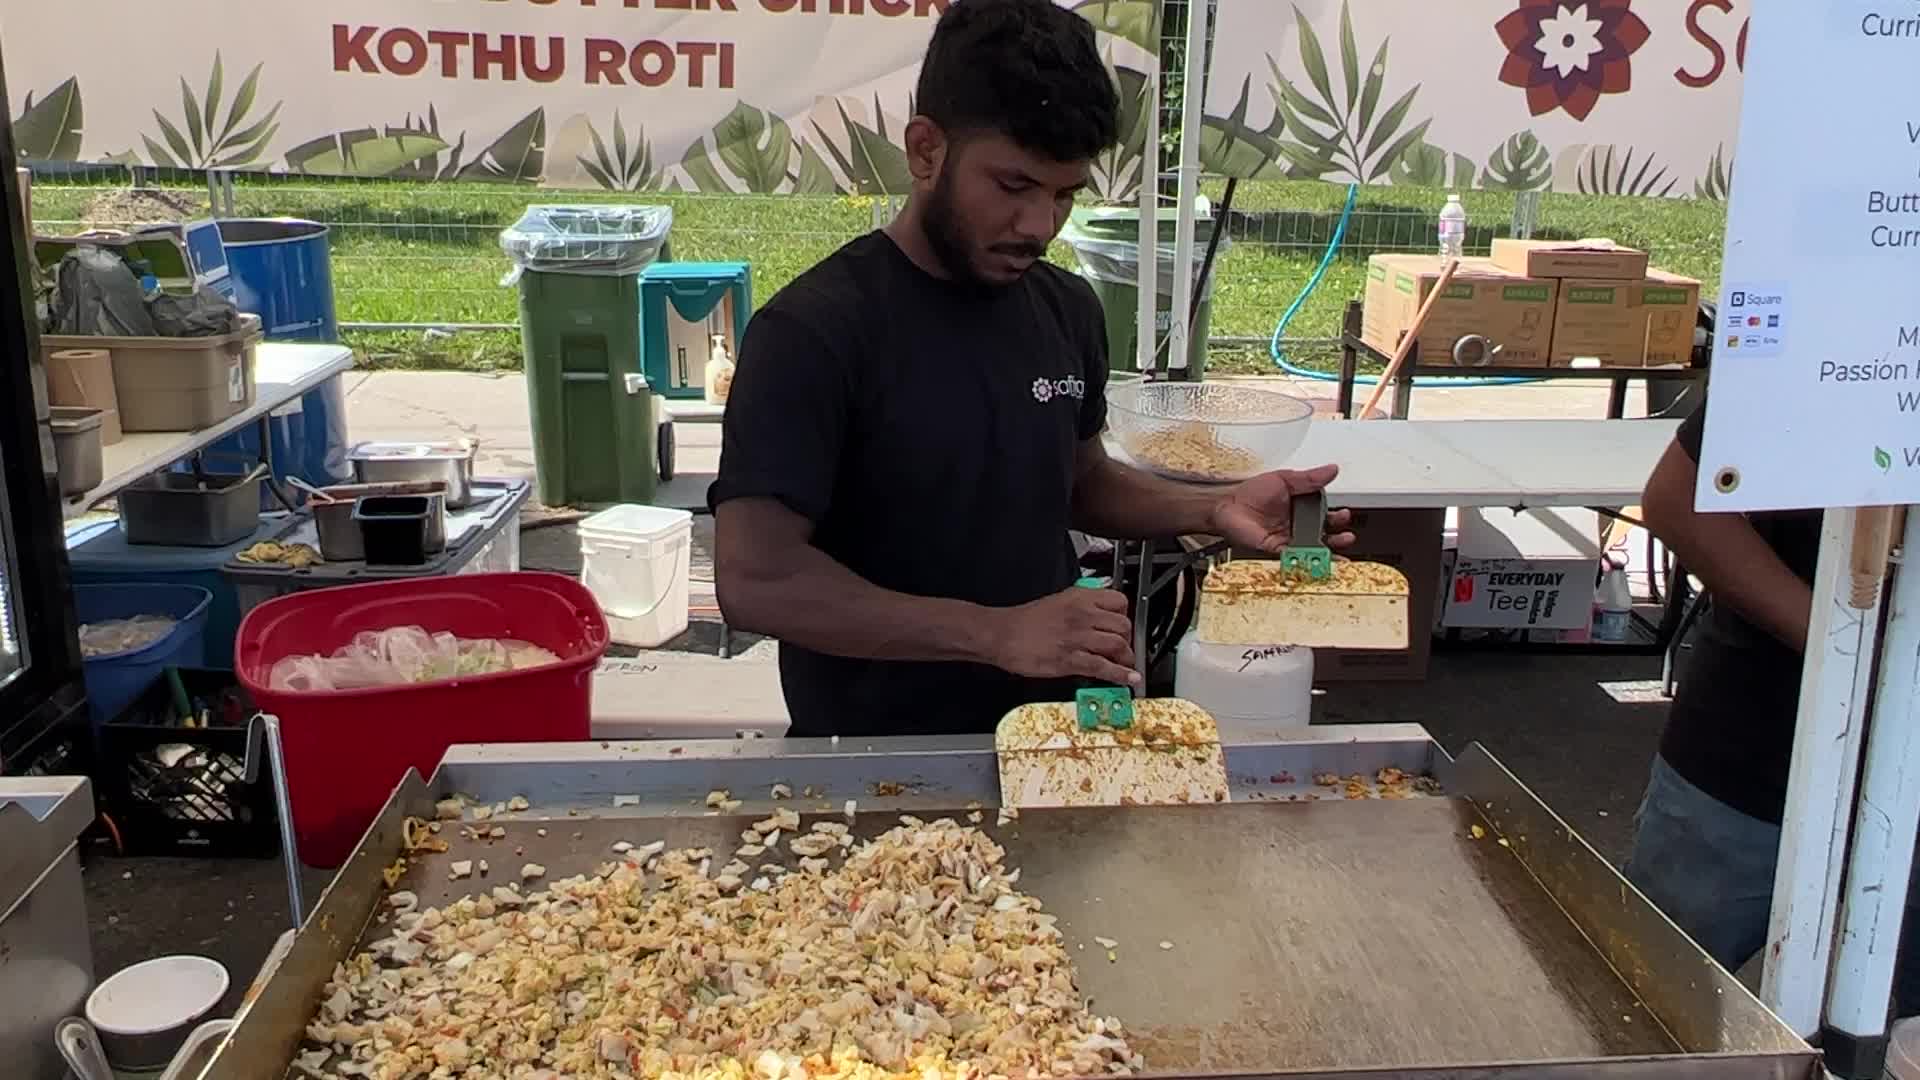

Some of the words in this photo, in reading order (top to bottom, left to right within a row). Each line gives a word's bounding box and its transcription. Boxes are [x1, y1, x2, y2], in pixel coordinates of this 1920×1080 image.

[333, 24, 565, 83] KOTHU
[585, 38, 735, 89] ROTI
[1898, 326, 1920, 347] M
[1819, 359, 1908, 382] Passion
[1488, 573, 1565, 586] EVERYDAY
[1487, 589, 1528, 611] Tee
